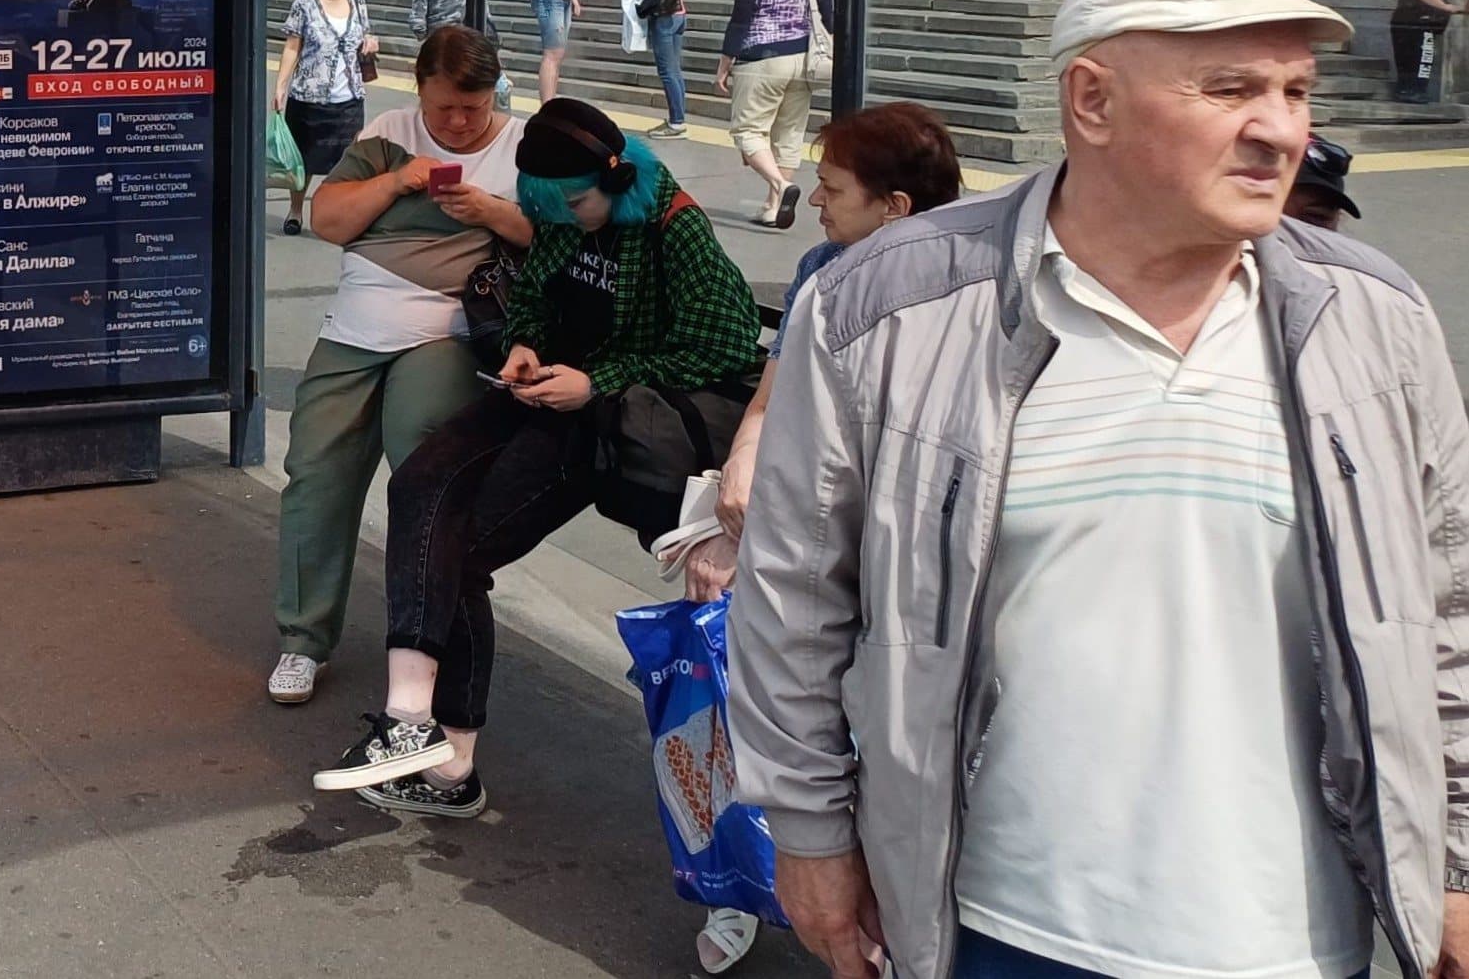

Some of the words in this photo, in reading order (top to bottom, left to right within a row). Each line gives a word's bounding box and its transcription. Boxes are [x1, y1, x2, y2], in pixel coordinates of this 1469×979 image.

[183, 37, 207, 48] 2024
[31, 38, 133, 71] 12-27
[138, 50, 206, 69] июля
[35, 81, 83, 94] ВХОД
[92, 74, 205, 92] СВОБОДНЫЙ
[135, 123, 176, 133] крепость
[0, 132, 71, 145] невидимом
[105, 145, 152, 154] ОТКРЫТИЕ
[153, 143, 204, 153] ФЕСТИВАЛЯ
[3, 199, 13, 209] в
[15, 194, 87, 210] Алжире»
[135, 233, 174, 244] Гатчина
[5, 255, 76, 273] Далила»
[569, 266, 596, 285] EAT
[12, 315, 65, 332] дама»
[106, 321, 152, 331] ЗАКРЫТИЕ
[152, 317, 204, 328] ФЕСТИВАЛЯ
[188, 339, 207, 353] 6+
